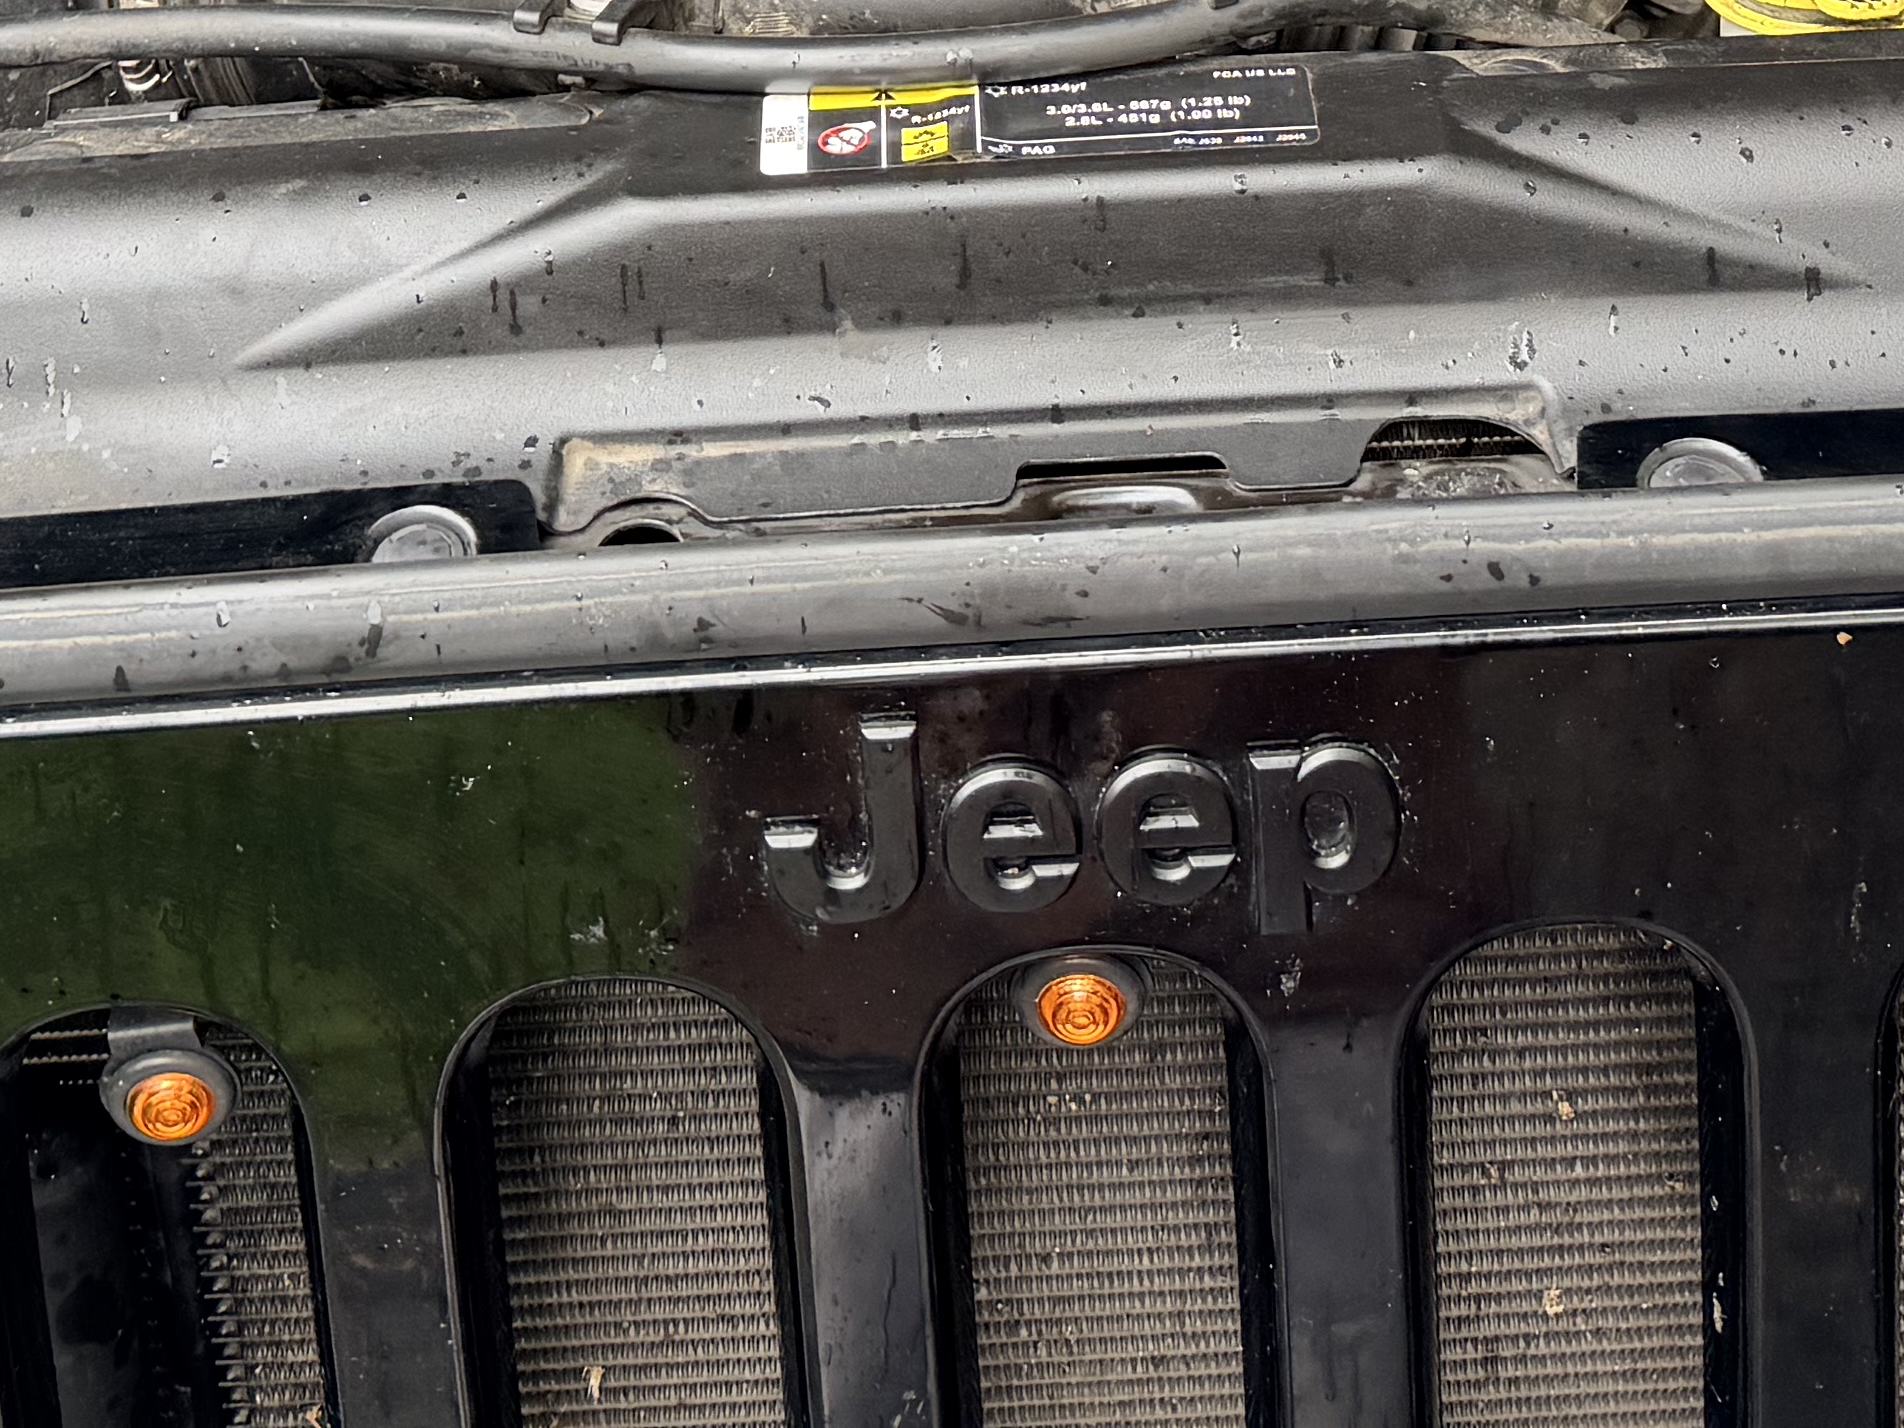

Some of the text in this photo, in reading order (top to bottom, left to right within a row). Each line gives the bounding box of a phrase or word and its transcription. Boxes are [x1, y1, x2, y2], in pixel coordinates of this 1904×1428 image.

[1212, 70, 1242, 79] FCA
[1011, 82, 1087, 96] R-1234yf
[1021, 145, 1056, 156] PAG
[763, 711, 1402, 934] Jeep
